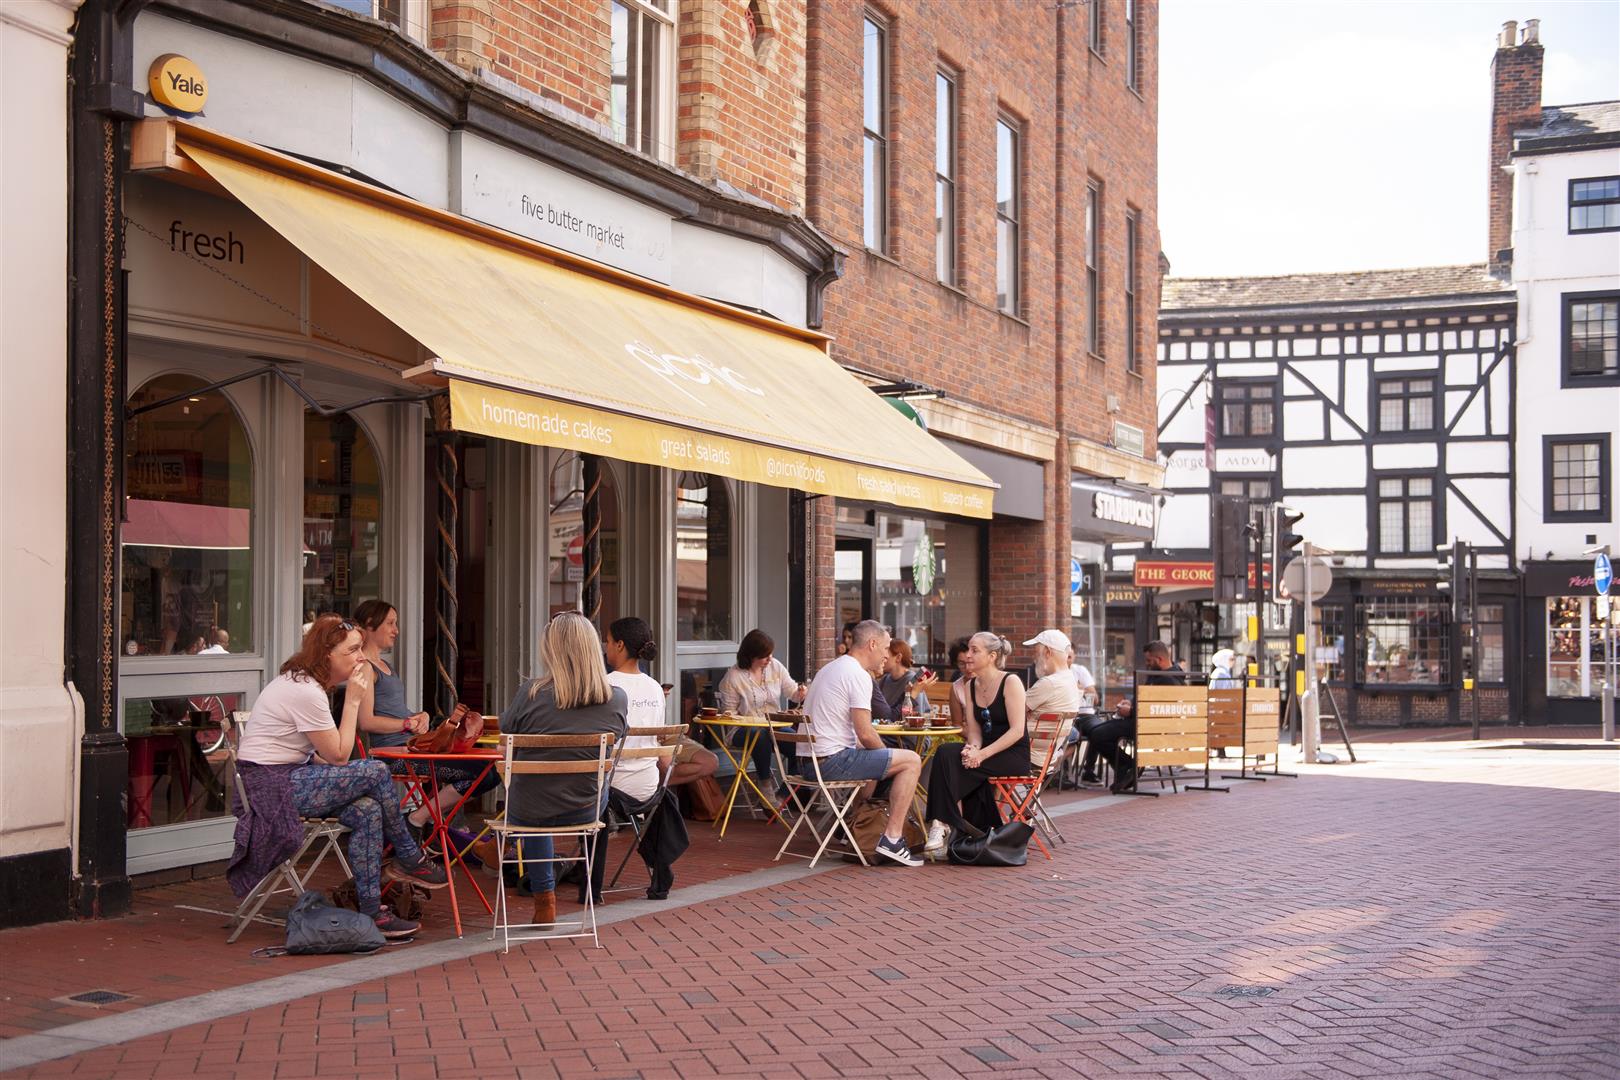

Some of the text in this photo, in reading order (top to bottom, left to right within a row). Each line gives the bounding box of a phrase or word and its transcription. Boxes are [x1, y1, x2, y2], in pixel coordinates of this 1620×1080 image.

[167, 71, 204, 97] Yale
[521, 194, 625, 250] five butter market
[169, 221, 245, 264] fresh
[482, 399, 613, 444] homemade cakes
[661, 438, 731, 465] great salads
[857, 472, 879, 491] fresh
[964, 494, 984, 509] coffee
[1095, 491, 1153, 528] STARBUCKS
[1138, 568, 1215, 581] THE GEORG
[1150, 704, 1197, 715] STARBUCKS
